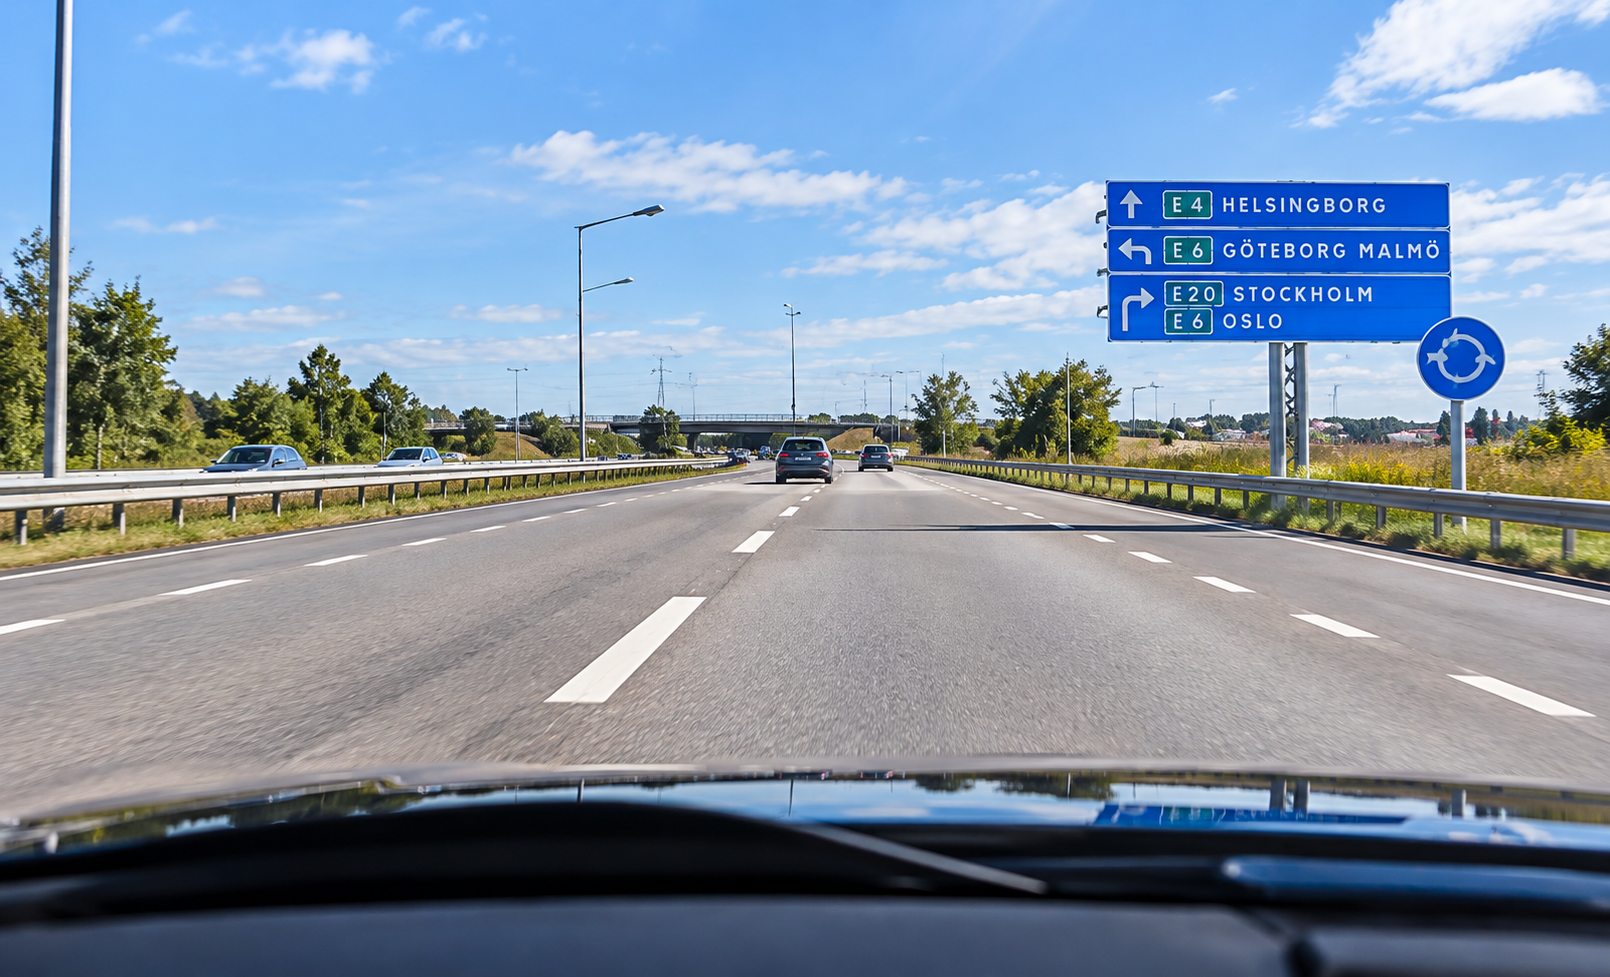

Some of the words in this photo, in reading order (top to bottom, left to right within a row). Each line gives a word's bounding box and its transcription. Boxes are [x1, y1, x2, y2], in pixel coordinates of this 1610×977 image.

[1222, 197, 1386, 214] HELSINGBORG
[1223, 238, 1346, 259] GÖTEBORG
[1359, 239, 1440, 259] MALMÖ
[1233, 286, 1372, 302] STOCKHOLM
[1222, 313, 1282, 329] OSLO
